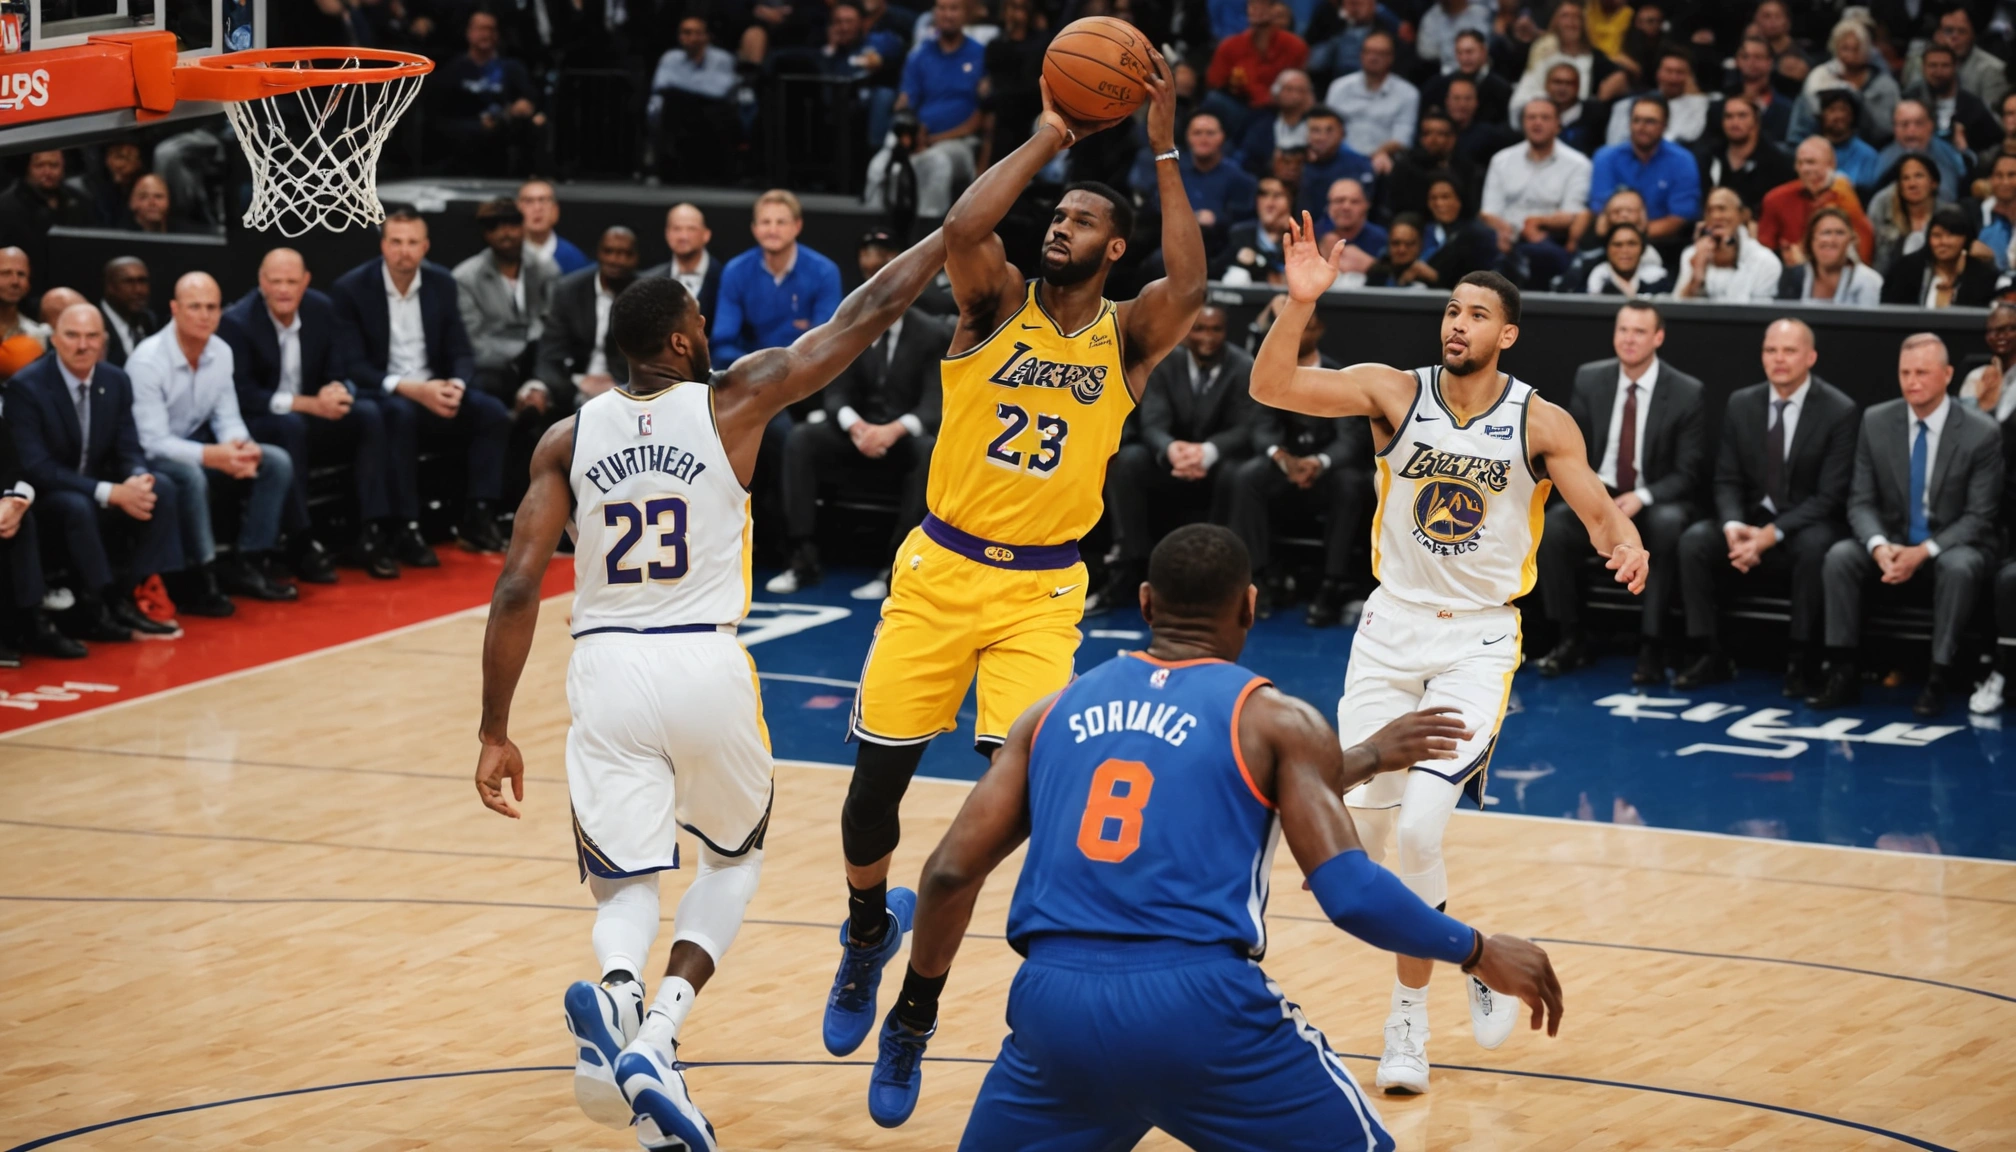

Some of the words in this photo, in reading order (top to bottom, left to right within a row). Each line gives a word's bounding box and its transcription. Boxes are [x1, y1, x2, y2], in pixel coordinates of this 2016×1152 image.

[987, 403, 1069, 473] 23
[604, 497, 689, 585] 23
[1076, 757, 1155, 864] 8
